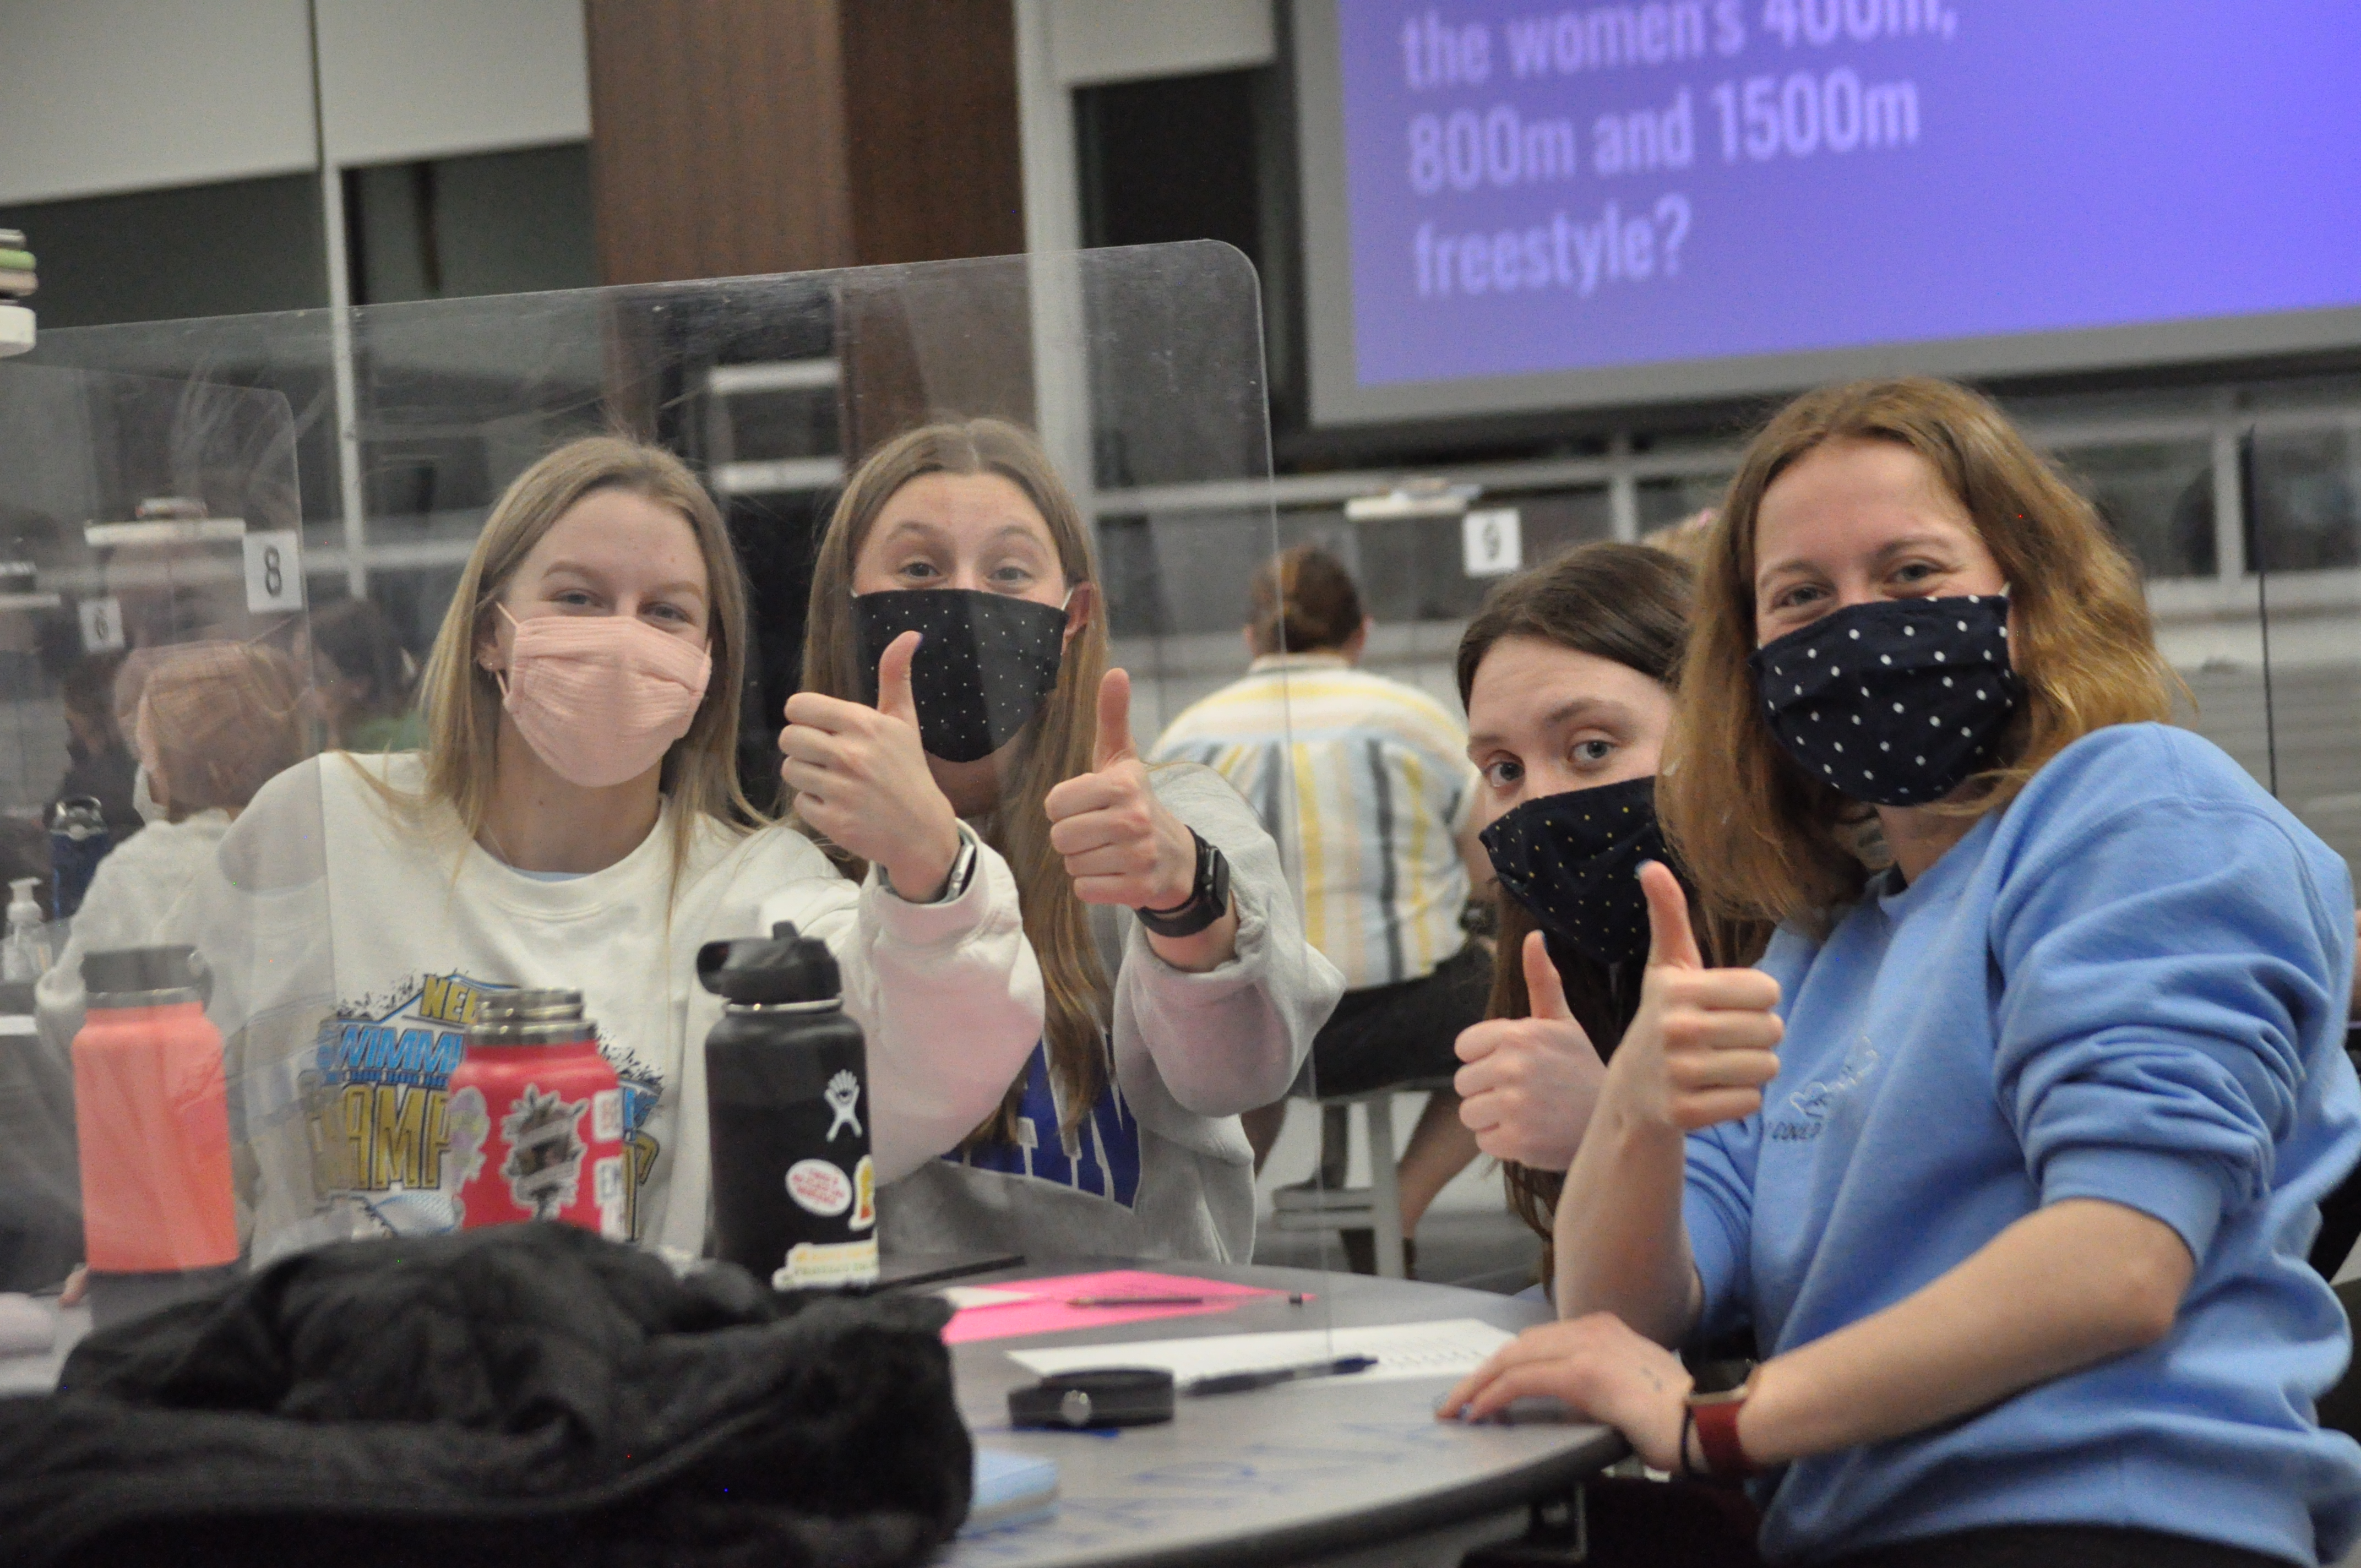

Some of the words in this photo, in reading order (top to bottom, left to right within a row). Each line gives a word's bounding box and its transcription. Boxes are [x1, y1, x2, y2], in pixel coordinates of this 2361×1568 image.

[1402, 14, 1491, 89] the
[1508, 0, 1747, 78] womens
[1408, 106, 1577, 194] 800m
[1590, 87, 1695, 175] and
[1711, 67, 1921, 163] 1500m
[1414, 193, 1691, 298] freestyle?
[264, 546, 282, 597] 8
